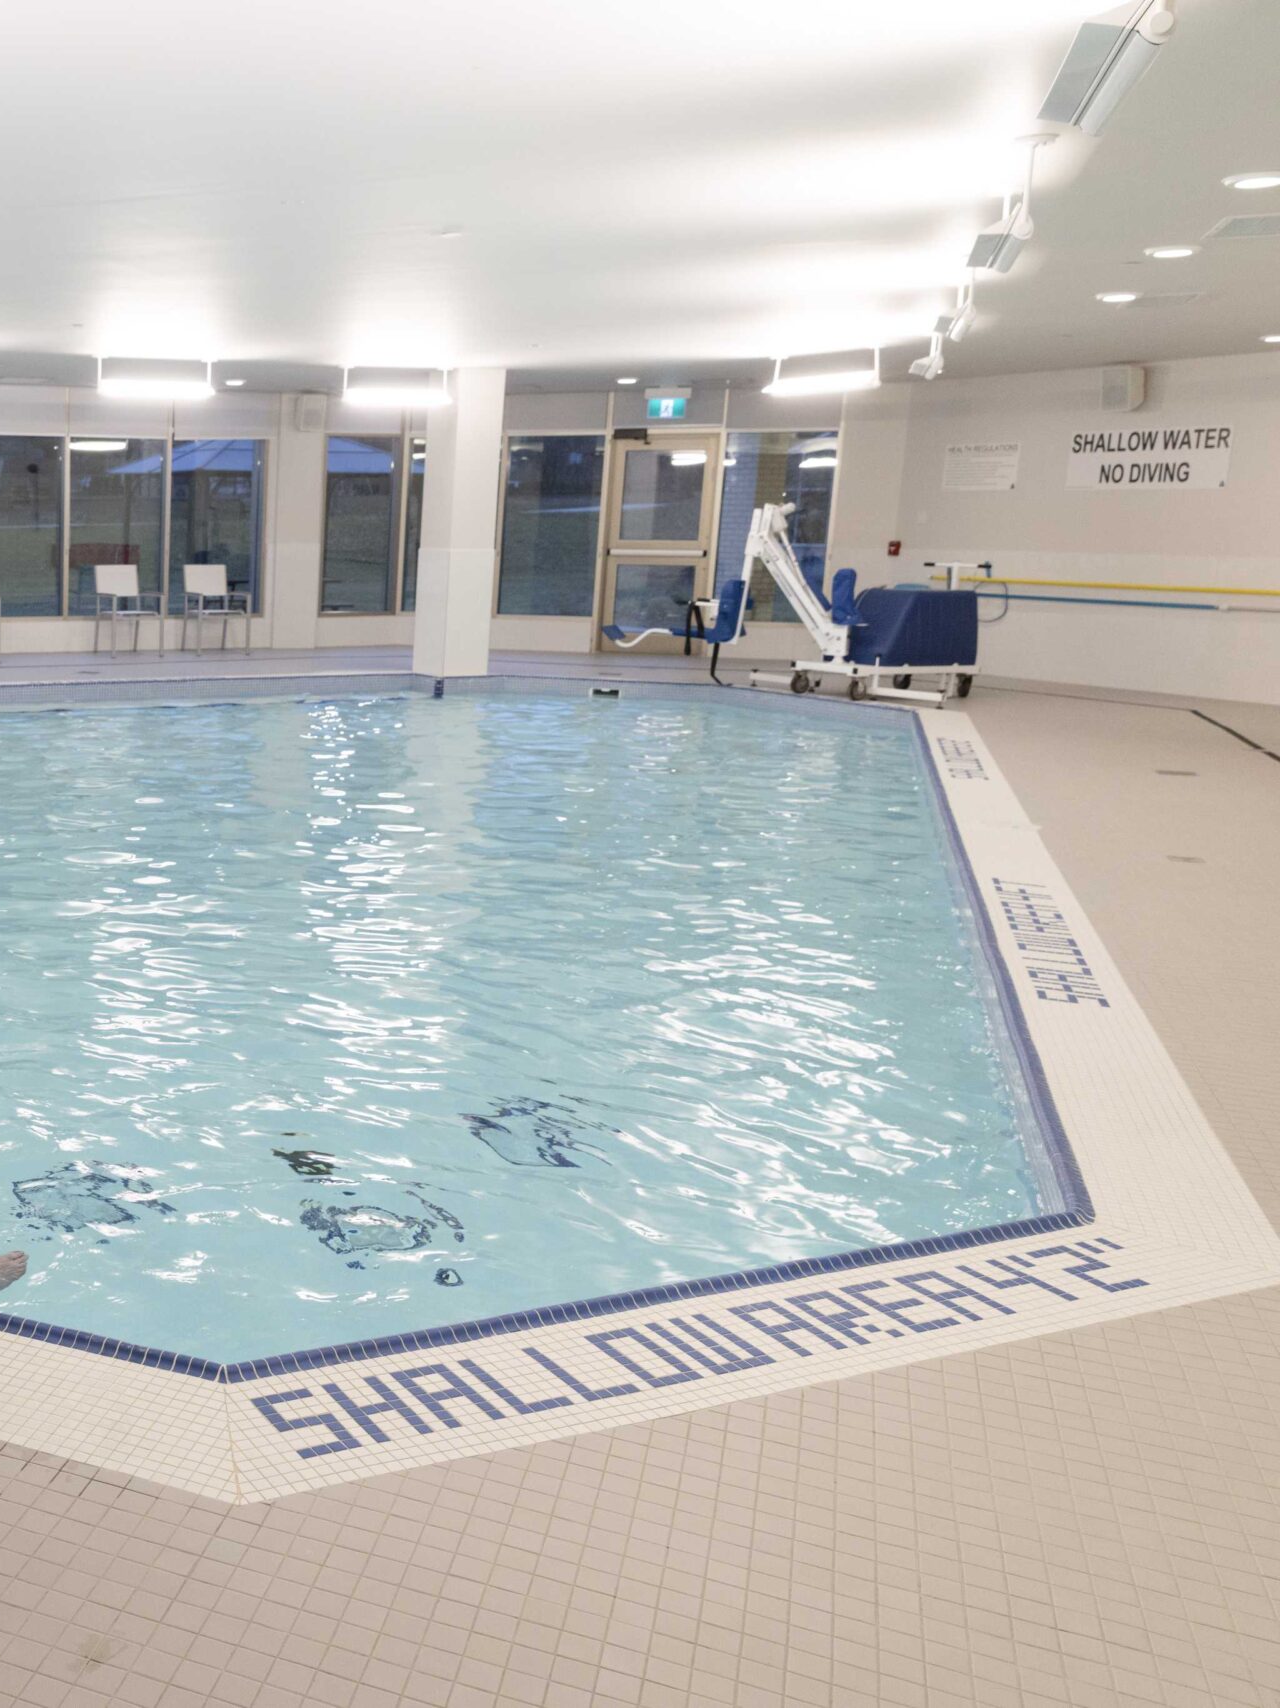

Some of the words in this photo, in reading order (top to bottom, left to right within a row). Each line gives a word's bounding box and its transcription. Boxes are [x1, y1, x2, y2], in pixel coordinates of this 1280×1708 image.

[1072, 431, 1158, 453] SHALLOW
[1163, 428, 1231, 450] WATER
[1099, 464, 1124, 483] NO
[1129, 462, 1190, 483] DIVING
[251, 1313, 777, 1460] SHALLOW
[726, 1270, 1017, 1358] AREA
